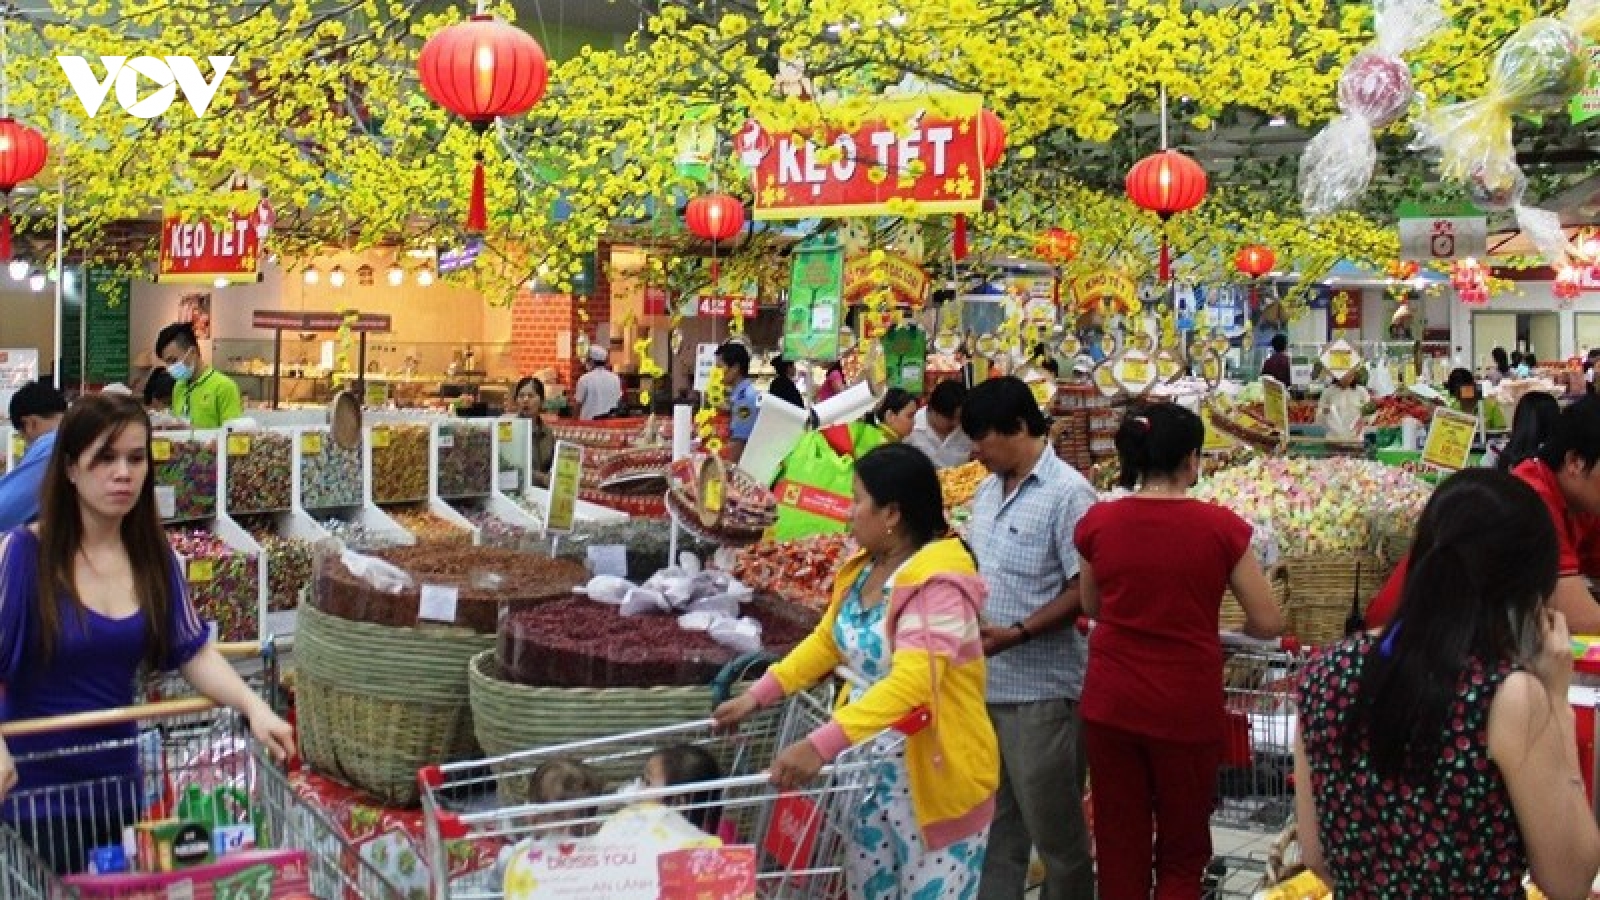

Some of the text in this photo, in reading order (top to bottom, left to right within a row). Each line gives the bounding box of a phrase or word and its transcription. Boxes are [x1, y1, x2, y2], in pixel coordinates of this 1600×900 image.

[778, 109, 953, 196] KẸO TẾT
[171, 221, 205, 268] KẸO
